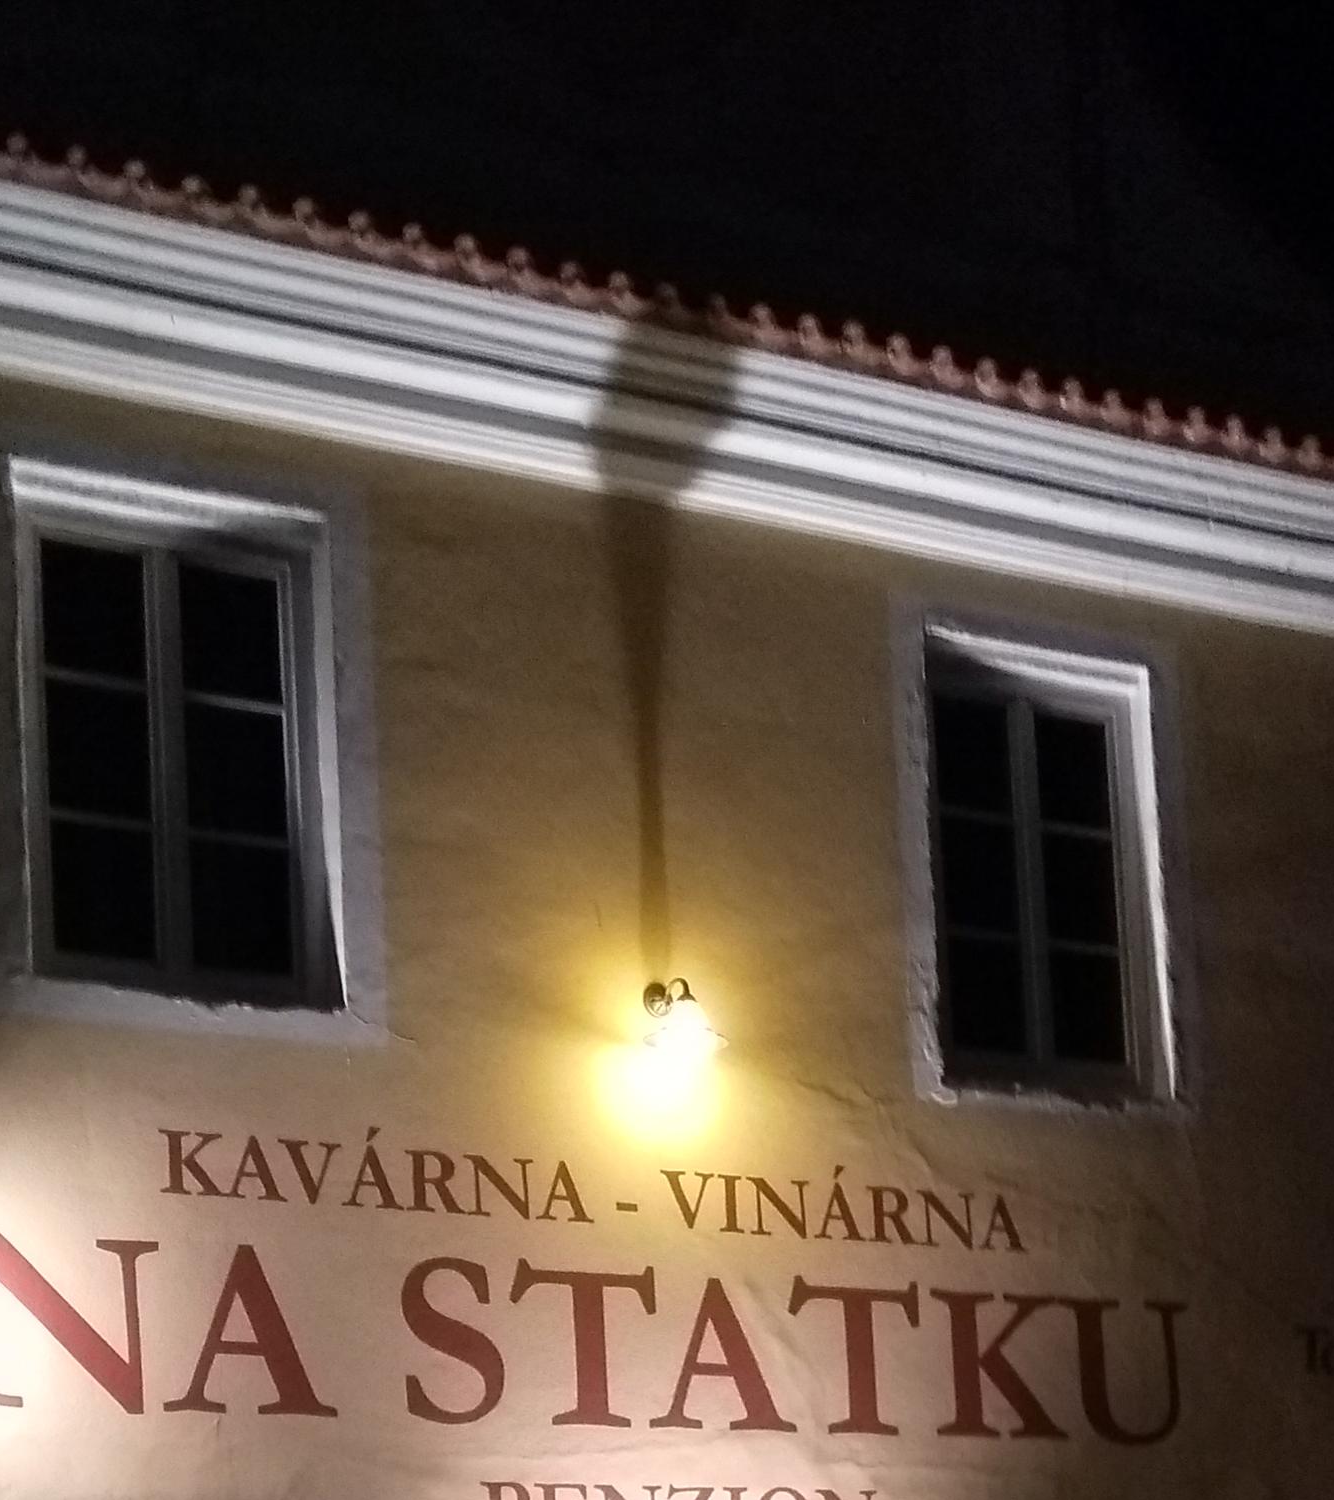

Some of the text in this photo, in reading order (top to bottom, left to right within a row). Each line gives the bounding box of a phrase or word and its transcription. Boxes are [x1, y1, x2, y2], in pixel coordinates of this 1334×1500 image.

[159, 1127, 594, 1223] KAVÁRNA
[661, 1165, 1028, 1252] VINÁRNA
[401, 1256, 1188, 1445] STATKU
